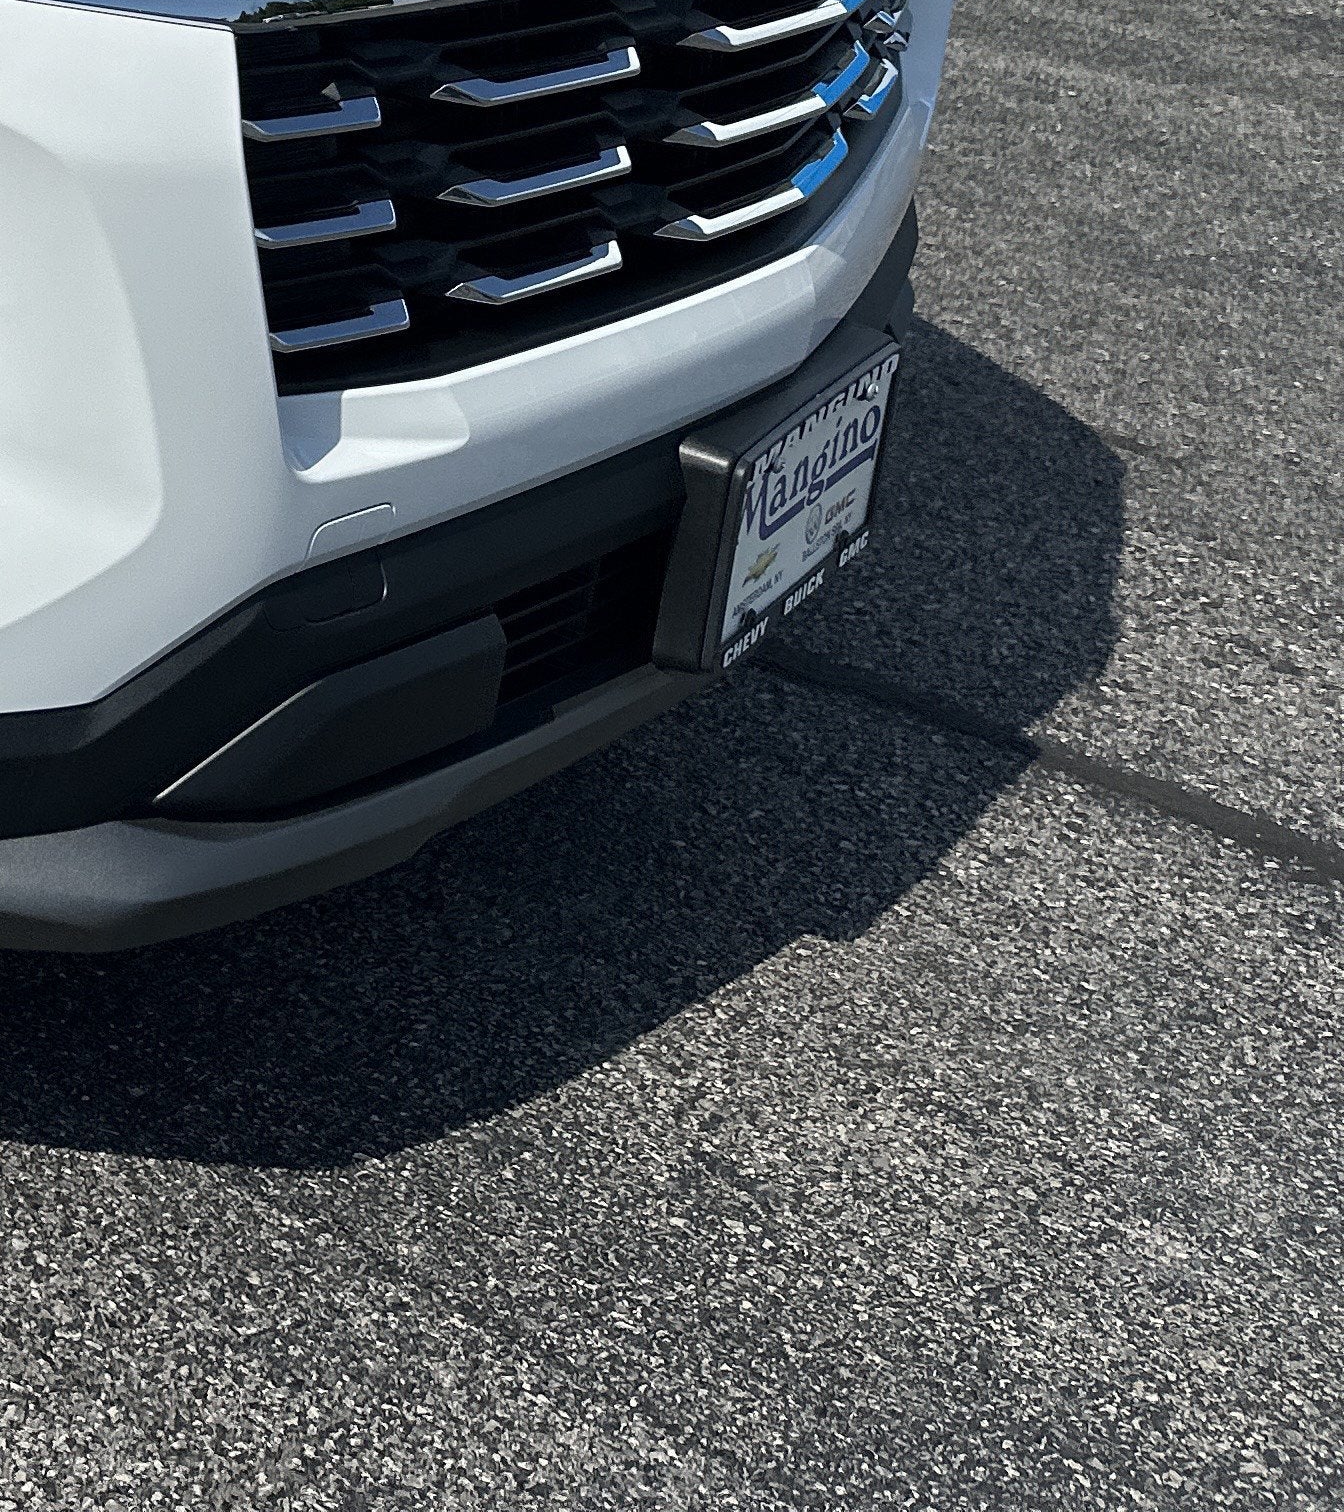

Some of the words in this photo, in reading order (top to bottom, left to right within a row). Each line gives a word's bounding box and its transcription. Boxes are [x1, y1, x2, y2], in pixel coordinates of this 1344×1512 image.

[744, 404, 881, 541] Mangino
[750, 354, 900, 478] MANGINO
[824, 488, 857, 525] GMC
[722, 616, 769, 668] CHEVY
[783, 567, 825, 616] BUICK
[838, 530, 870, 568] GMC
